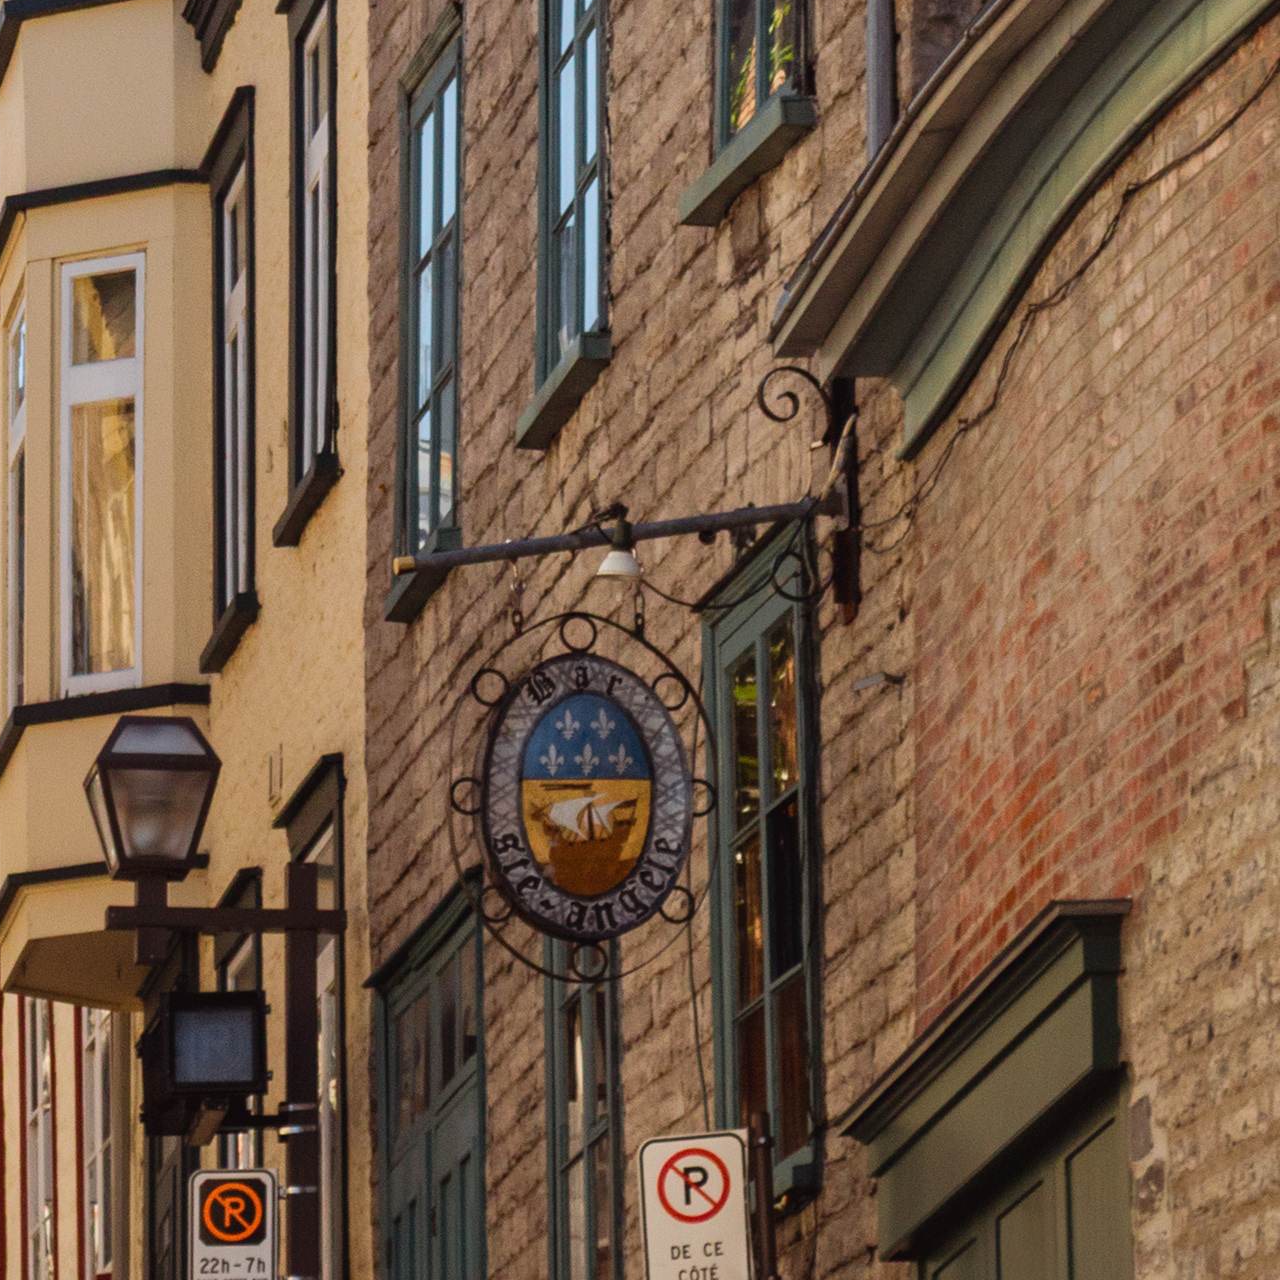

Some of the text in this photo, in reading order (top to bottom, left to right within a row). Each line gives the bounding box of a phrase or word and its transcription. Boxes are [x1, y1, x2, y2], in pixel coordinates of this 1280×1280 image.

[670, 1241, 724, 1260] DE CE
[677, 1263, 721, 1280] CÔTÉ
